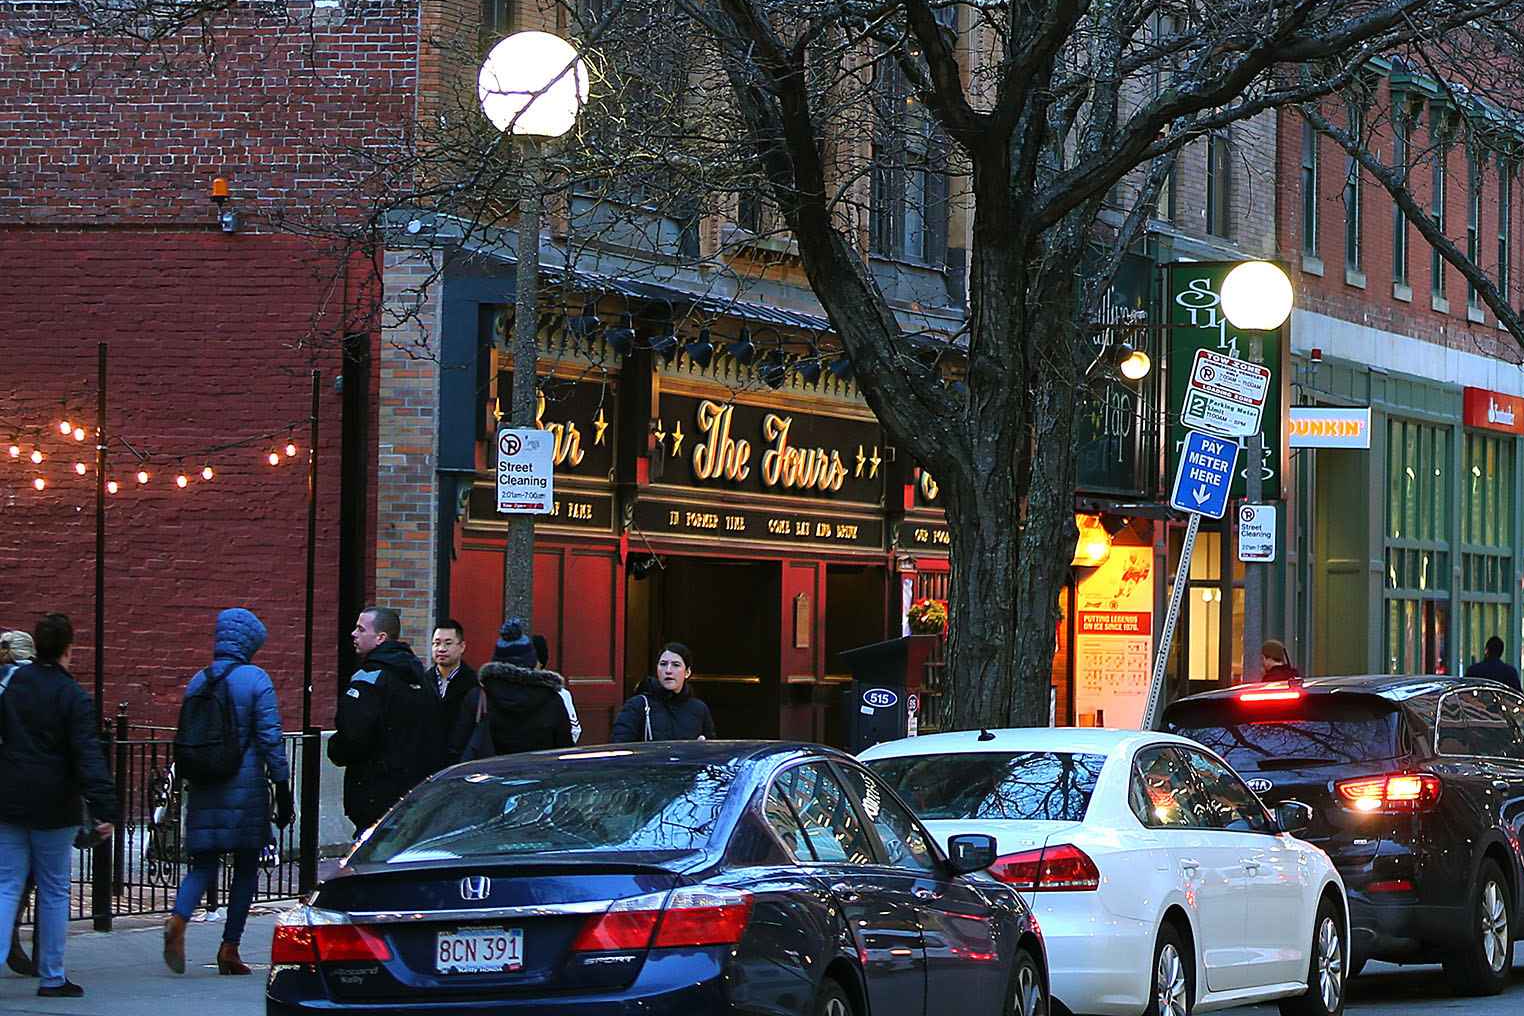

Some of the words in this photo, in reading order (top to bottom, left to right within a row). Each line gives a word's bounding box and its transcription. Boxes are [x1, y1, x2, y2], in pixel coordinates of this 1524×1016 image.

[1206, 352, 1230, 365] TOW
[1232, 360, 1262, 374] ZONE
[1202, 385, 1233, 398] LOADING
[1234, 394, 1253, 404] ZONE
[1191, 398, 1205, 411] 2
[1209, 399, 1235, 411] Parking
[1237, 407, 1257, 417] Meter
[1207, 405, 1225, 415] Limit
[693, 399, 751, 482] The
[1200, 439, 1225, 455] PAY
[500, 461, 533, 473] Street
[1188, 451, 1229, 473] METER
[499, 474, 547, 488] Cleaning
[1189, 467, 1222, 487] HERE
[567, 502, 593, 520] FAME
[669, 511, 680, 525] IN
[768, 518, 791, 534] COME
[795, 521, 810, 536] EAT
[815, 522, 832, 537] AND
[1241, 523, 1262, 531] Street
[1241, 530, 1272, 539] Cleaning
[1083, 615, 1110, 623] PUTTING
[1110, 615, 1138, 624] LEGENDS
[1094, 623, 1103, 631] ICE
[1104, 623, 1122, 631] SINCE
[869, 693, 889, 704] 515
[440, 939, 476, 963] 8CN
[483, 937, 519, 961] 391
[583, 955, 636, 965] SPORT
